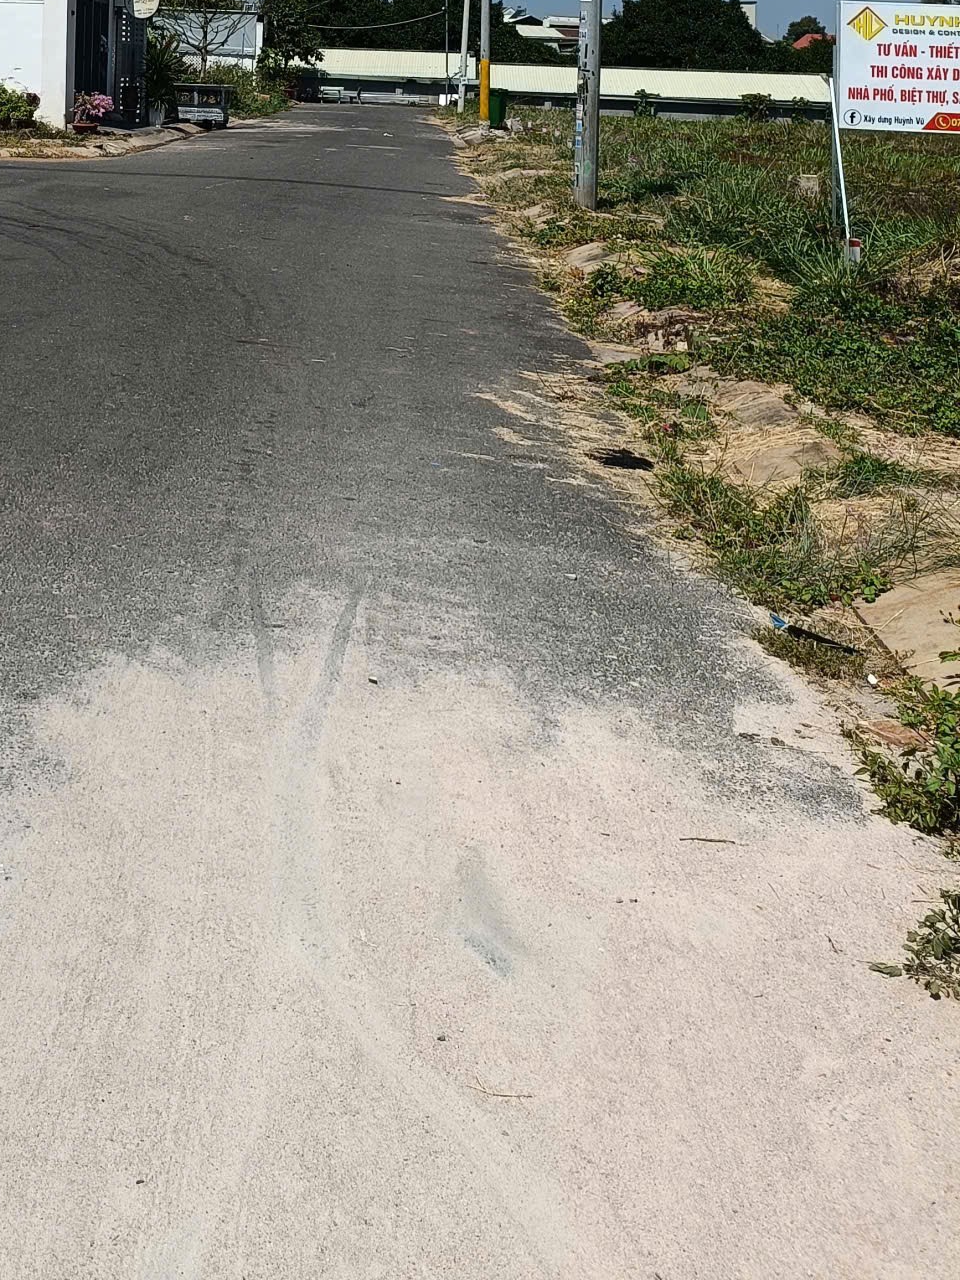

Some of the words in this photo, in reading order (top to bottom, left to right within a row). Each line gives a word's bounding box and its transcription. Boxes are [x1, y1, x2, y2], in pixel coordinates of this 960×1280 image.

[892, 28, 926, 36] DESIGN
[877, 42, 892, 57] TƯ
[894, 40, 918, 58] VẤN
[928, 41, 960, 60] THIẾT
[870, 65, 888, 79] THI
[891, 63, 923, 80] CÔNG
[926, 64, 949, 81] XÂY
[848, 84, 870, 101] NHÀ
[872, 83, 897, 103] PHỐ,
[900, 86, 923, 106] BIỆT
[926, 89, 949, 107] THỰ,
